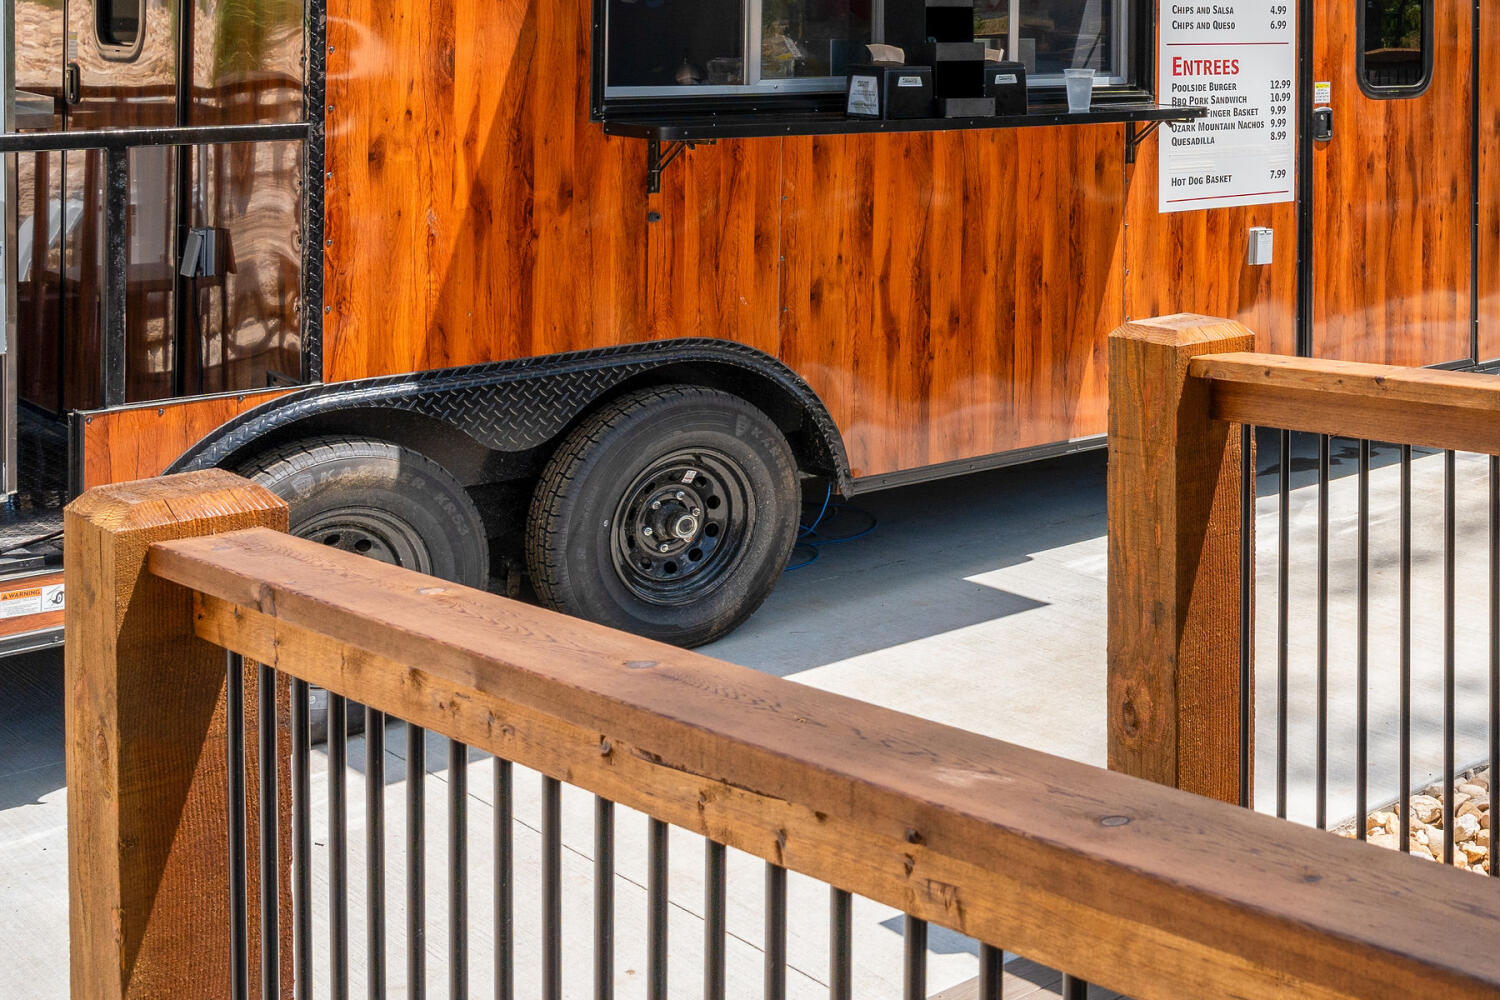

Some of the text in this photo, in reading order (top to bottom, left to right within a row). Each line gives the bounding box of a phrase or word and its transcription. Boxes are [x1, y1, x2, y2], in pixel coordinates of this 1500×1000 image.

[1172, 5, 1287, 15] CHIPS AND SALSA 4.99
[1172, 20, 1194, 30] CHIPS
[1213, 20, 1236, 30] QUESO
[1270, 20, 1287, 30] 6.99
[1172, 56, 1239, 76] ENTREES
[1172, 80, 1291, 92] POOLSIDE BURGER 12.99
[1172, 93, 1291, 106] BBQ PORK SANDWICH 10.99
[1233, 108, 1259, 117] BASKET
[1270, 106, 1286, 115] 9.99
[1172, 119, 1286, 133] OZARK MOUNTAIN NACHOS 9.99
[1171, 132, 1286, 146] QUESADILLA 8.99
[1171, 169, 1286, 187] HOT DOG BASKET 7.99
[8, 590, 40, 598] WARNING
